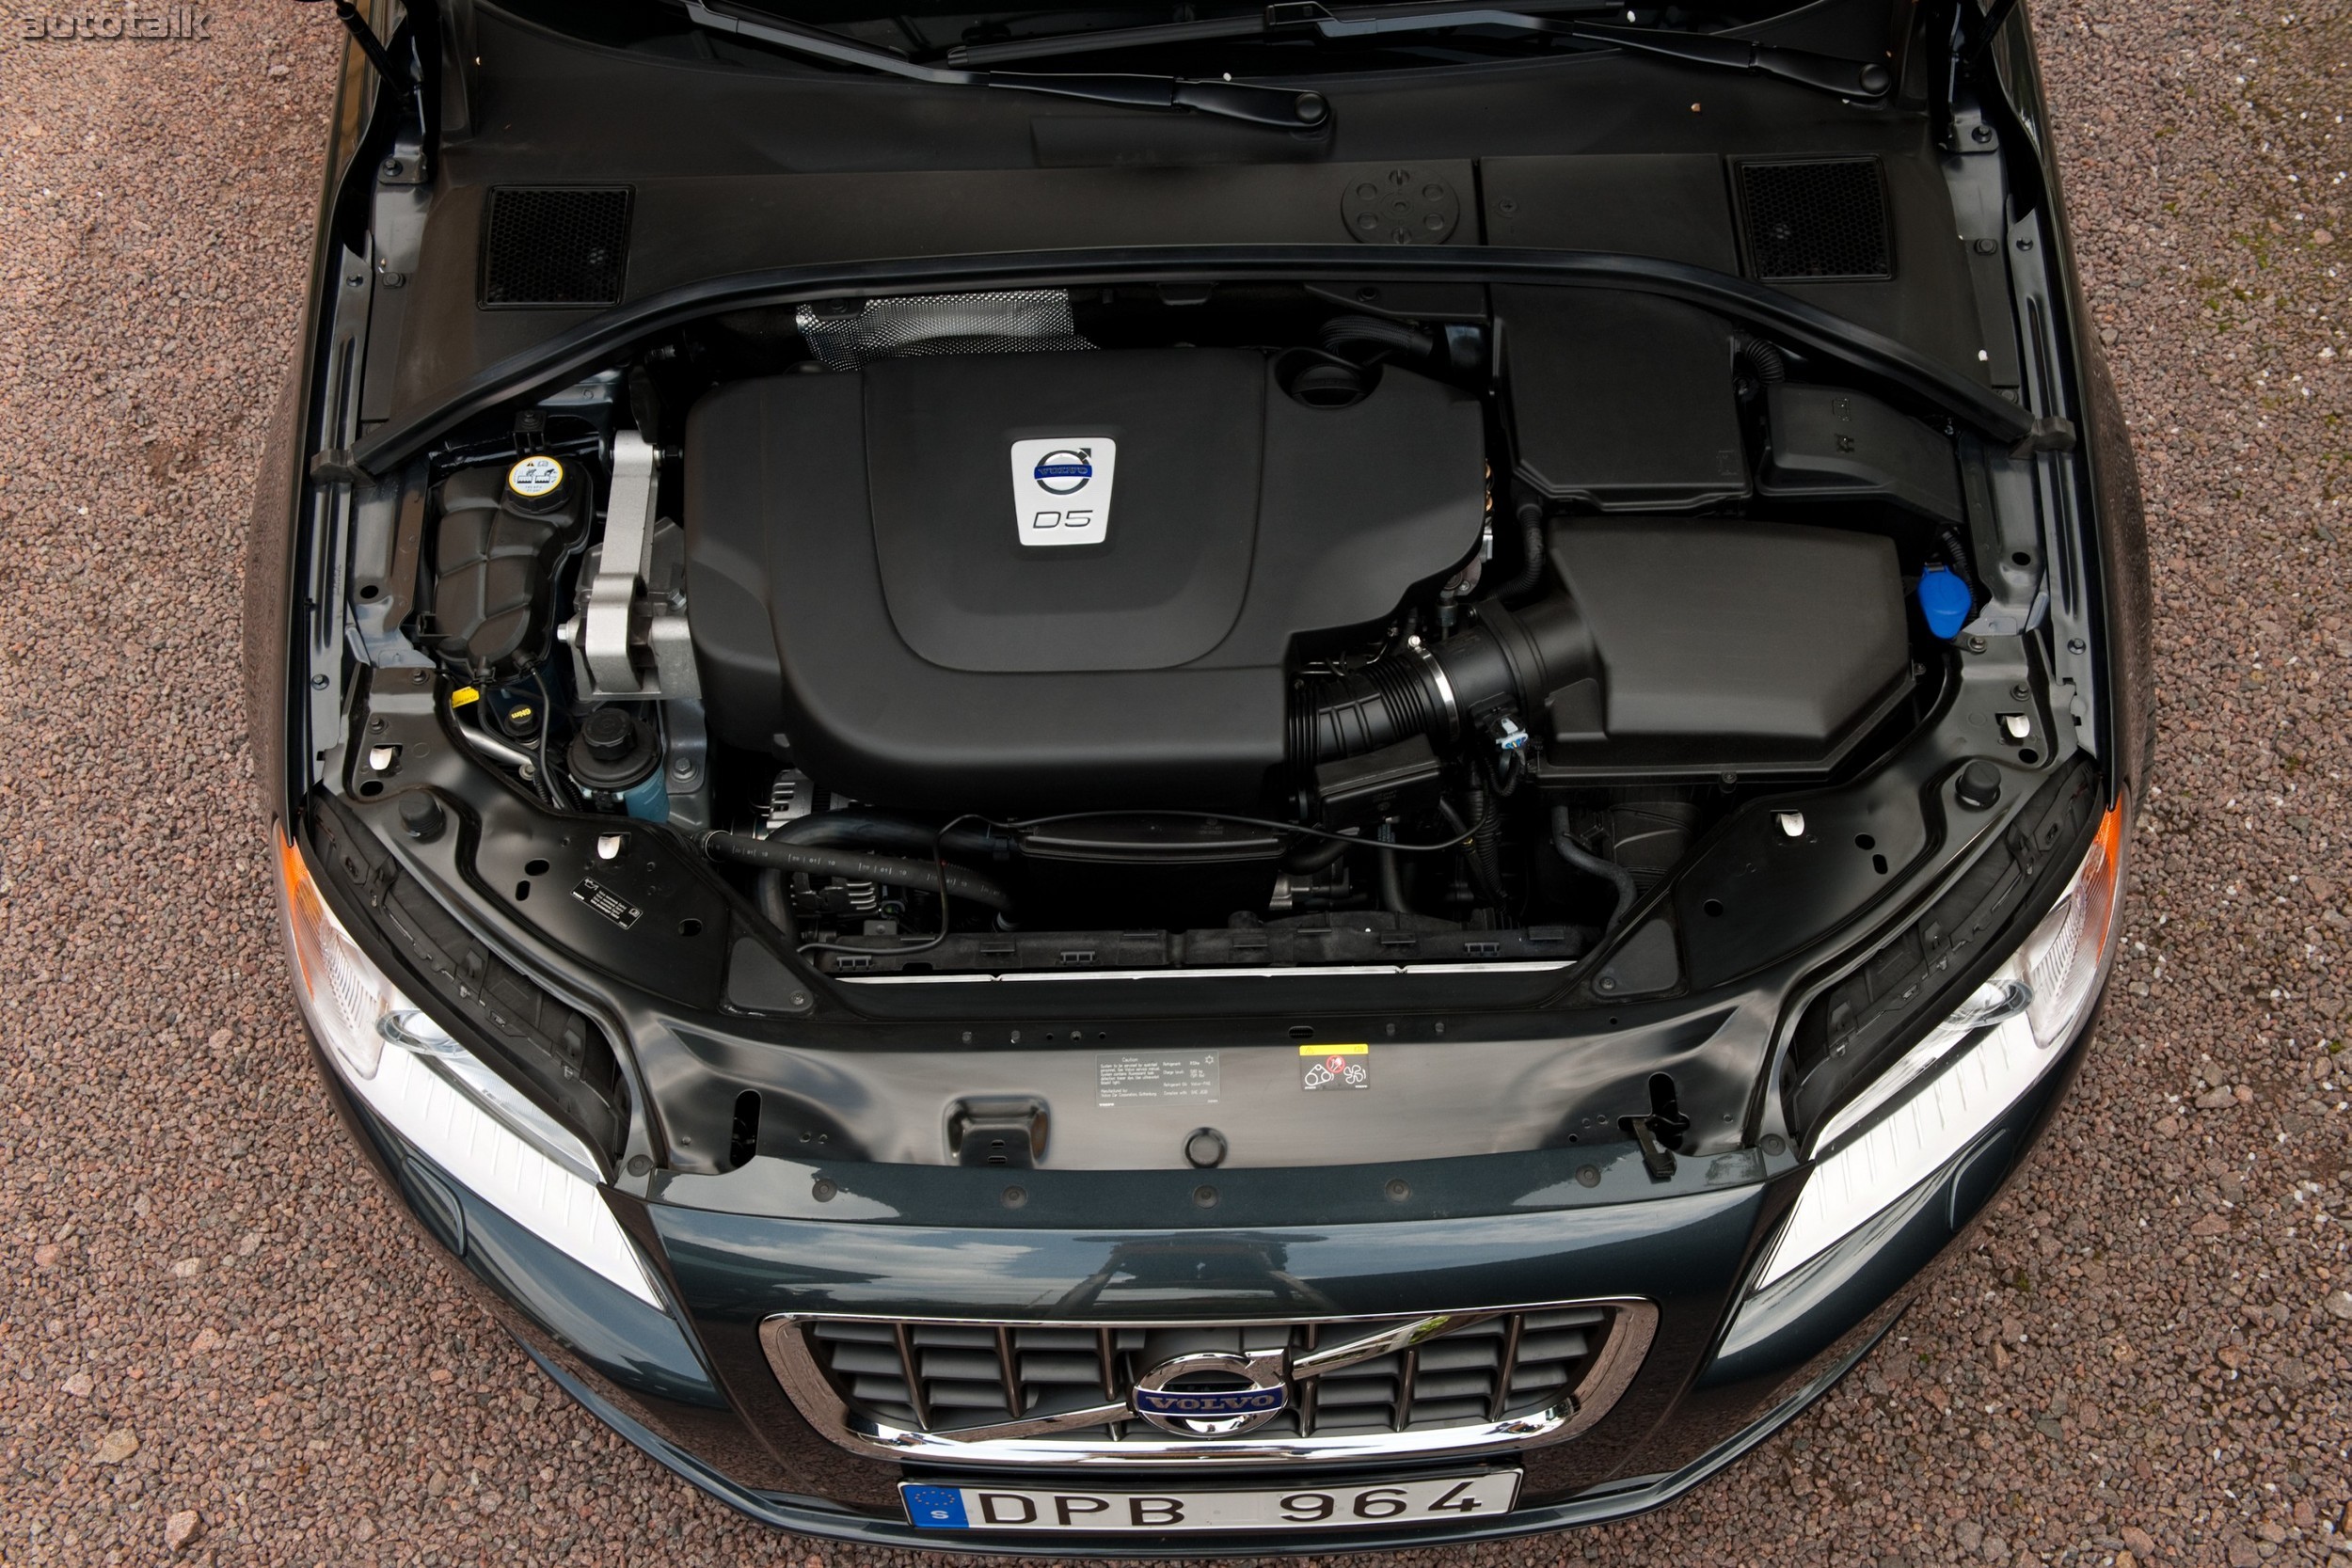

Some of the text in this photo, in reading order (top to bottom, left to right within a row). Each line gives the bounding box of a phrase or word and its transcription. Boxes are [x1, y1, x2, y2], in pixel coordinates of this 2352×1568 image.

[1033, 510, 1093, 529] D5
[1145, 1395, 1275, 1410] VOLVO
[930, 1481, 1483, 1526] S DPB 964
